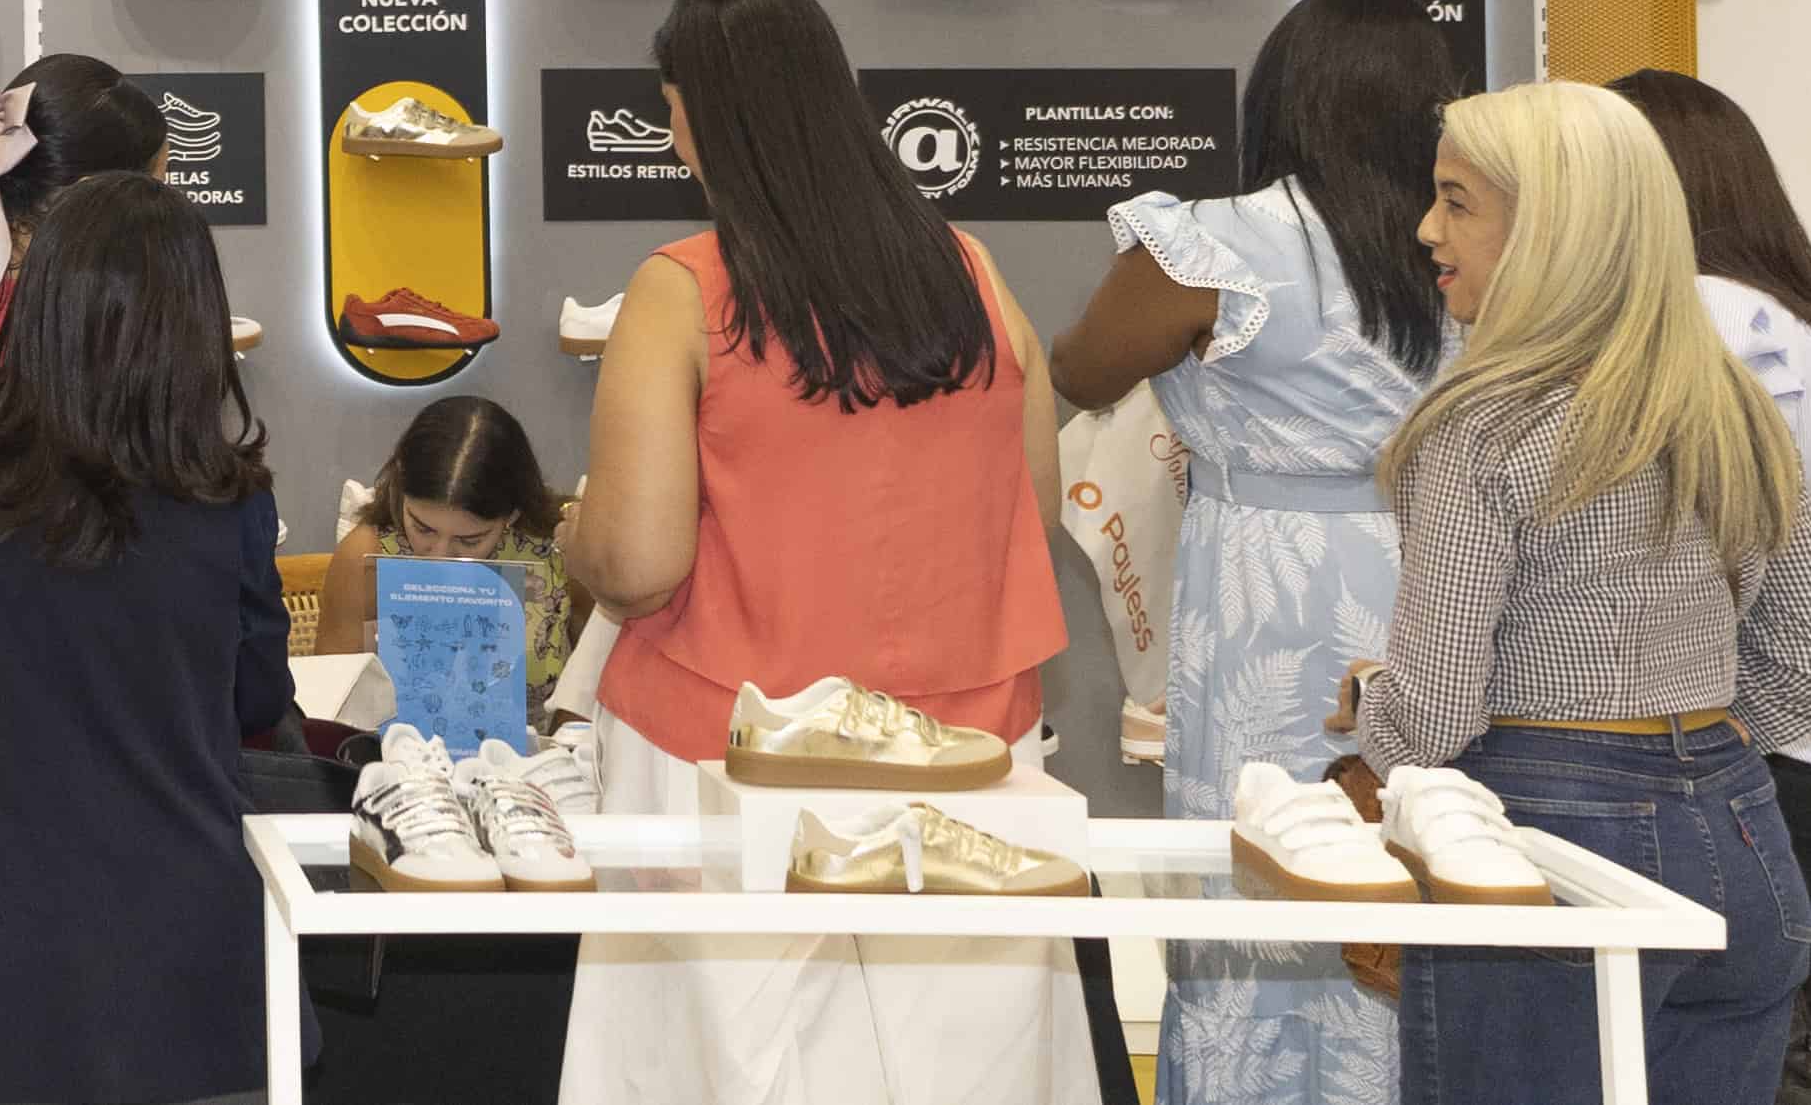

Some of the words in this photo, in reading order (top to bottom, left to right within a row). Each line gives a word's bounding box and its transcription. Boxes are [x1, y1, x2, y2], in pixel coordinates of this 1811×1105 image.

[339, 10, 467, 33] COLECCIÓN
[1025, 107, 1125, 121] PLANTILLAS
[1129, 106, 1174, 120] CON:
[1014, 138, 1118, 151] RESISTENCIA
[1123, 137, 1216, 150] MEJORADA
[1015, 156, 1074, 170] MAYOR
[1079, 155, 1187, 169] FLEXIBILIDAD
[568, 164, 632, 178] ESTILOS
[637, 165, 691, 179] RETRO
[1017, 172, 1053, 188] MÁS
[1057, 174, 1131, 188] LIVIANAS
[1101, 512, 1154, 653] Payless
